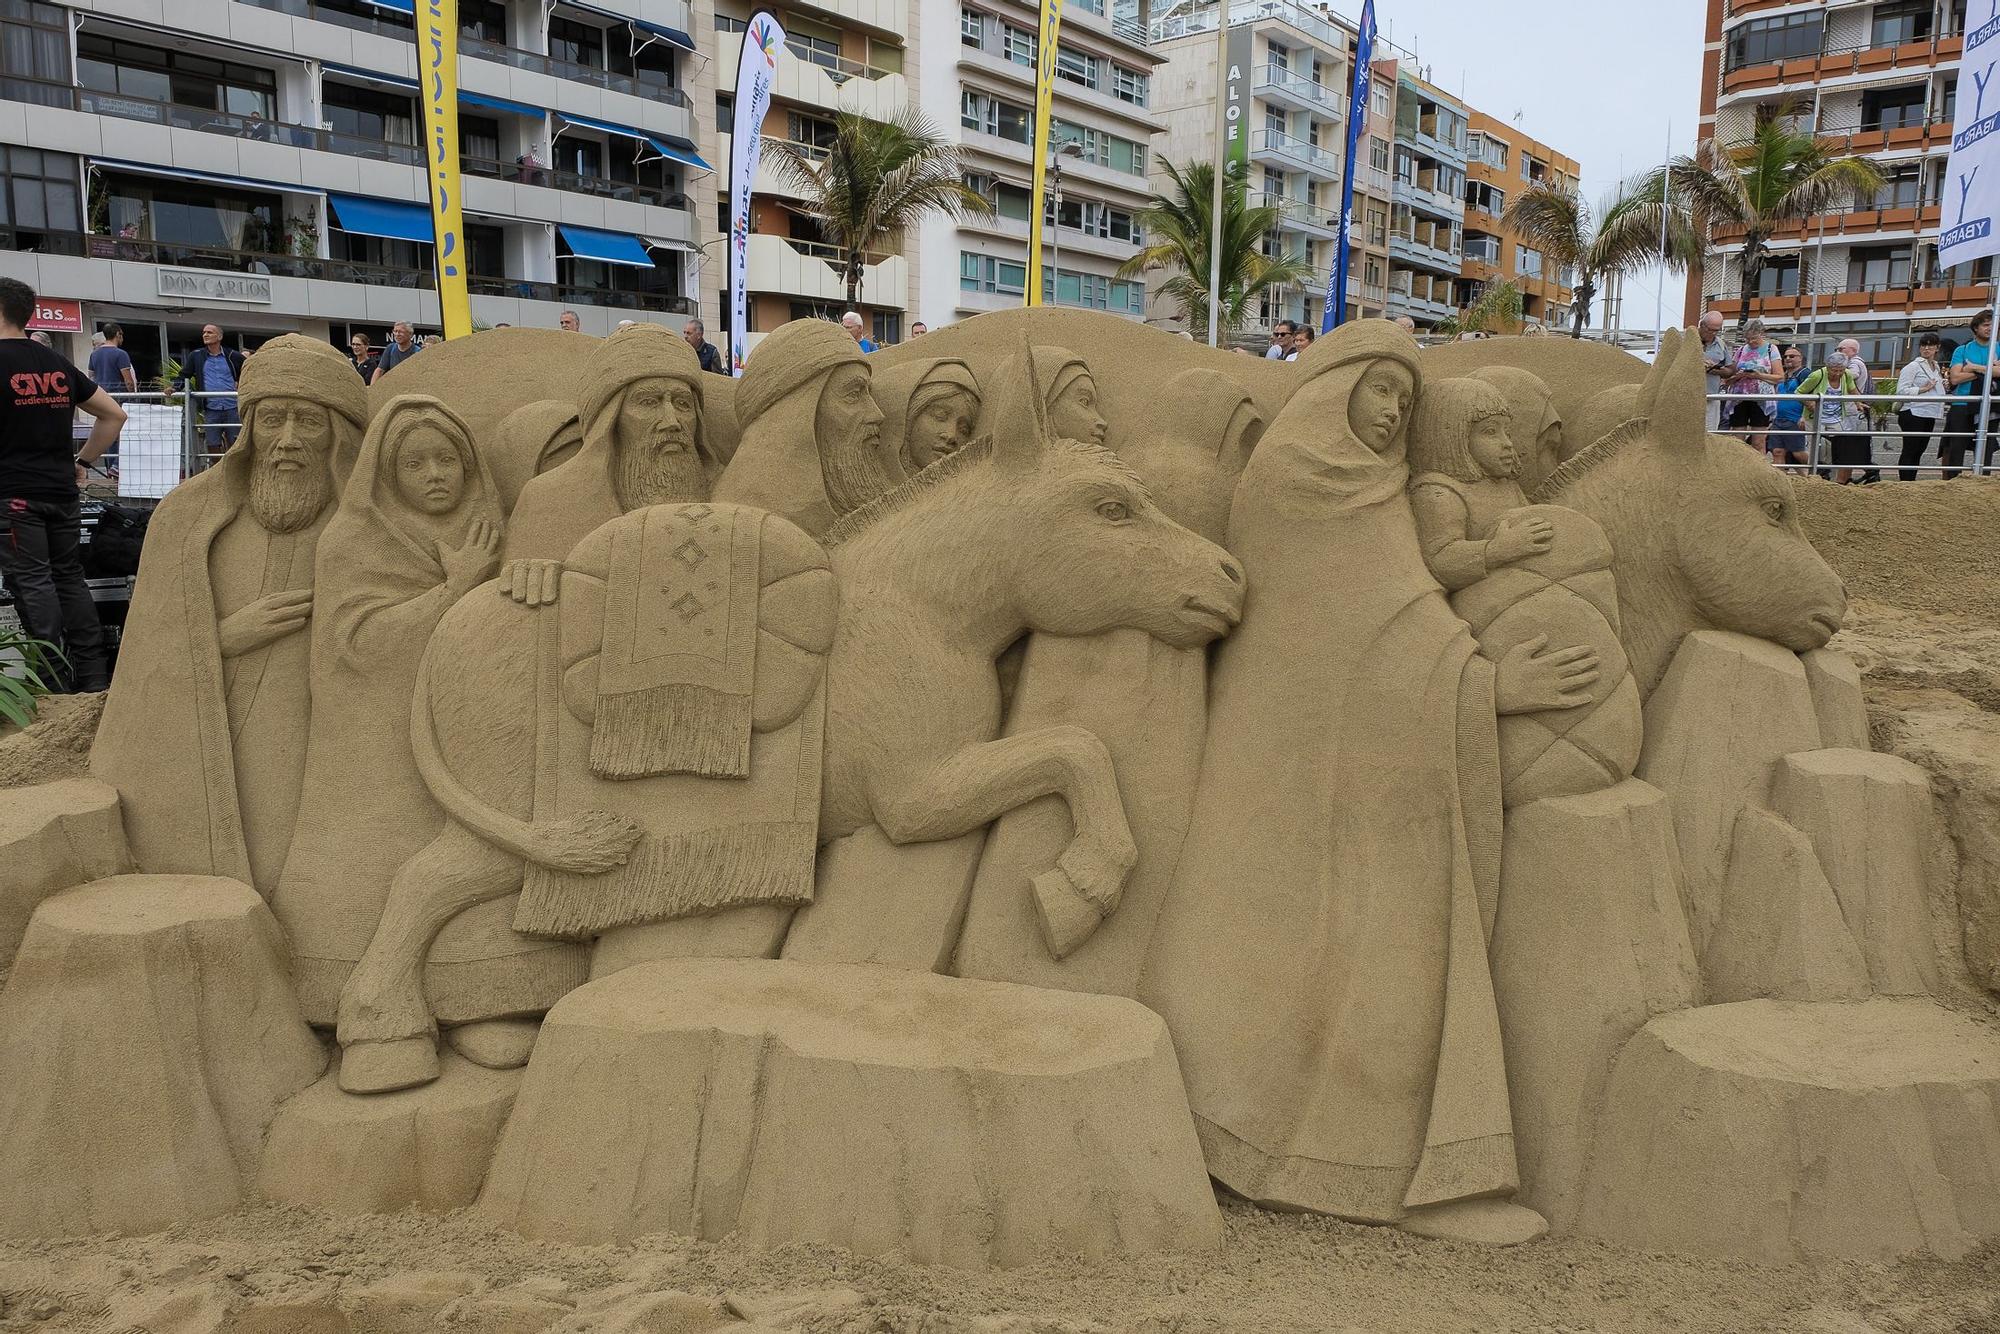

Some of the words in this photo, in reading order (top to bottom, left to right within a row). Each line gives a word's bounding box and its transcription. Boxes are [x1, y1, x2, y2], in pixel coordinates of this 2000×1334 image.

[1226, 65, 1242, 141] ALOE
[165, 274, 198, 291] DON
[202, 277, 270, 298] CARLOS
